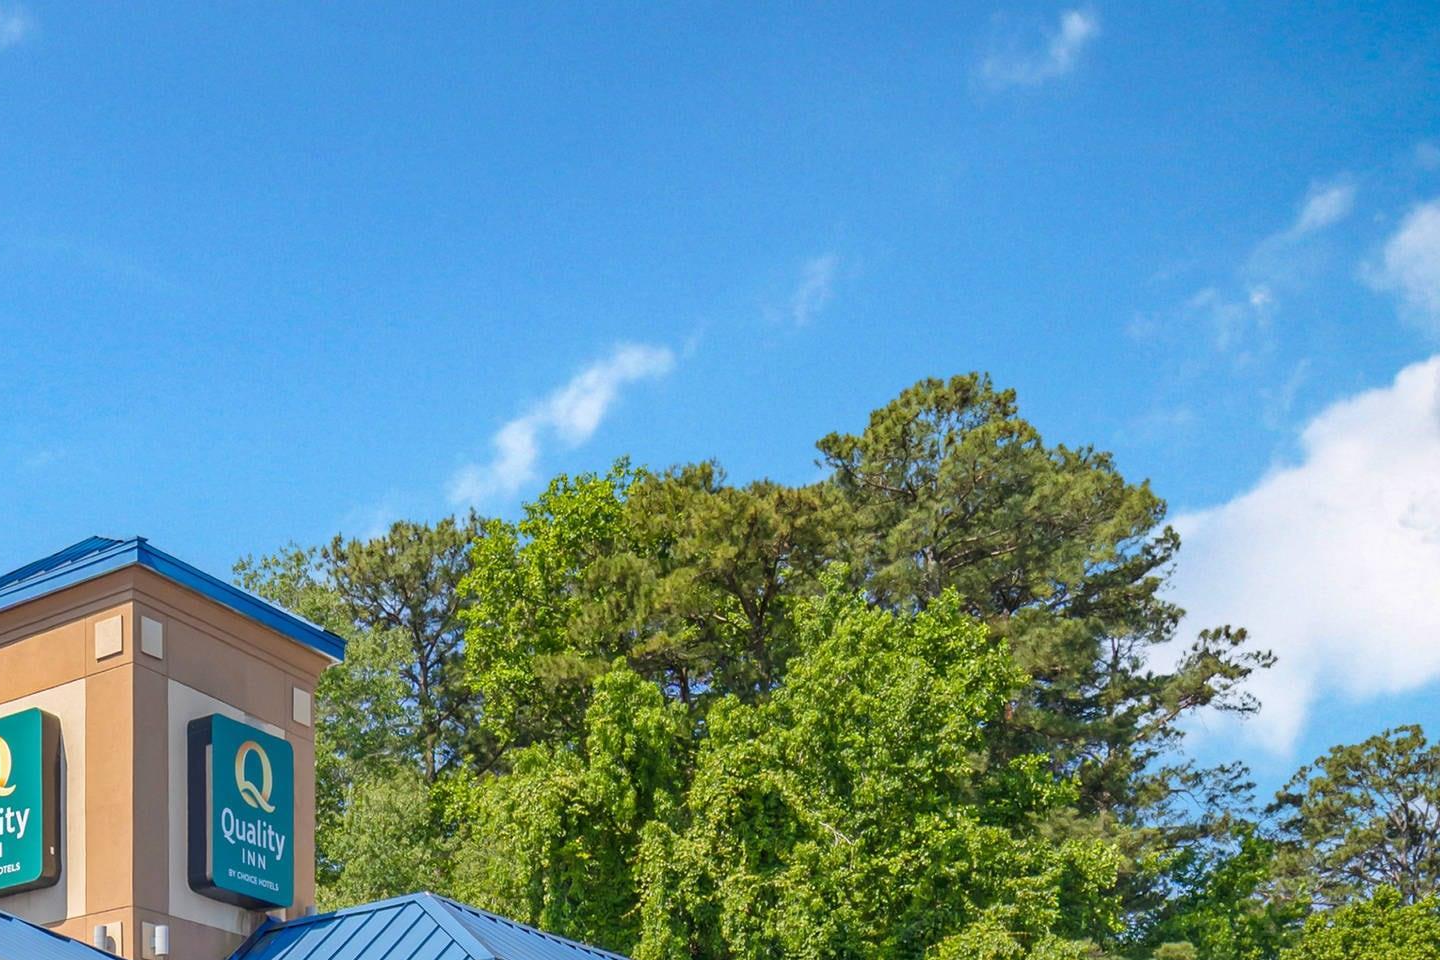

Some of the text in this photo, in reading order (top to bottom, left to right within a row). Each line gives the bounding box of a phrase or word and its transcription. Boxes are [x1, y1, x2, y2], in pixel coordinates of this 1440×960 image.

[235, 741, 276, 813] Q
[221, 807, 286, 861] Quality
[242, 847, 266, 870] INN
[228, 868, 279, 892] BY CHOICE HOTELS
